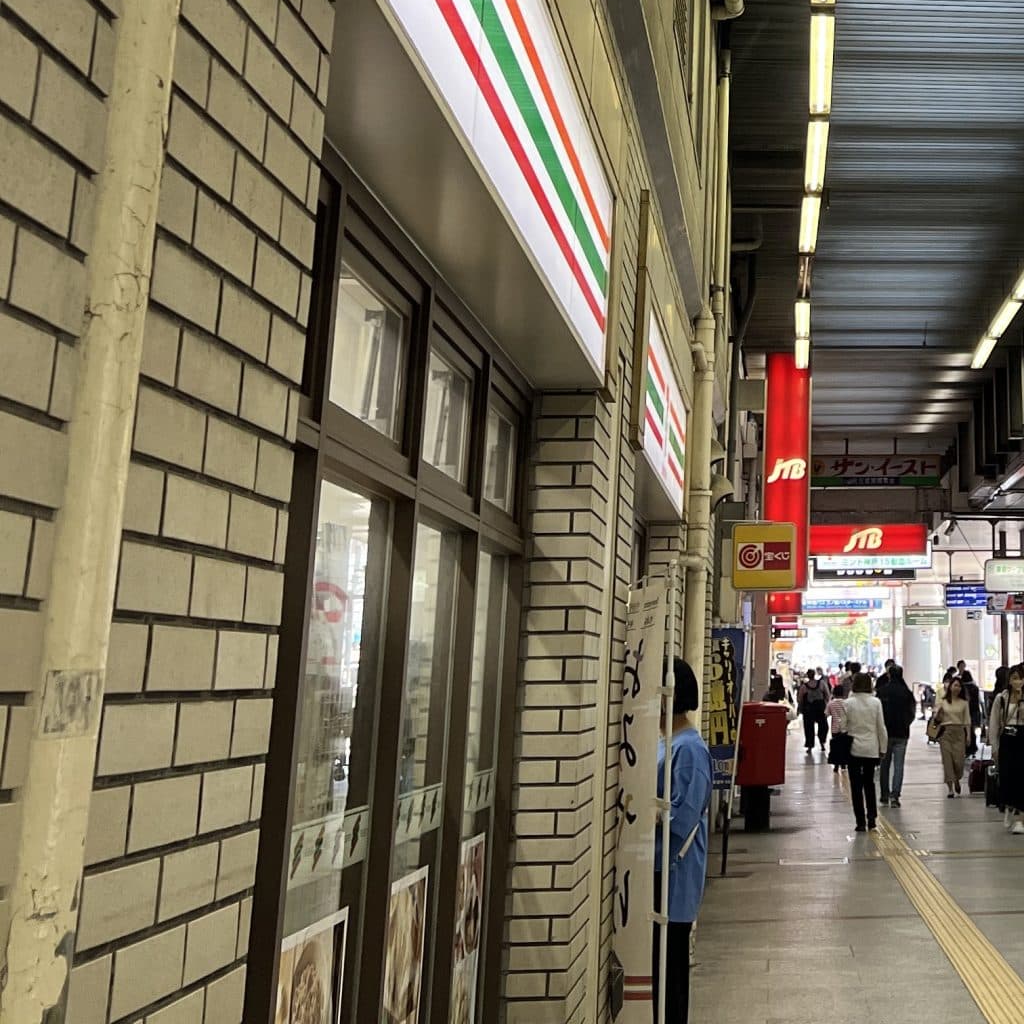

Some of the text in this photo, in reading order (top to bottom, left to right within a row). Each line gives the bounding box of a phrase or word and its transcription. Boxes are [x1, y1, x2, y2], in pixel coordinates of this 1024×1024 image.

[767, 458, 806, 483] JTB
[843, 528, 883, 552] JTB
[764, 552, 790, 561] 宝くじ
